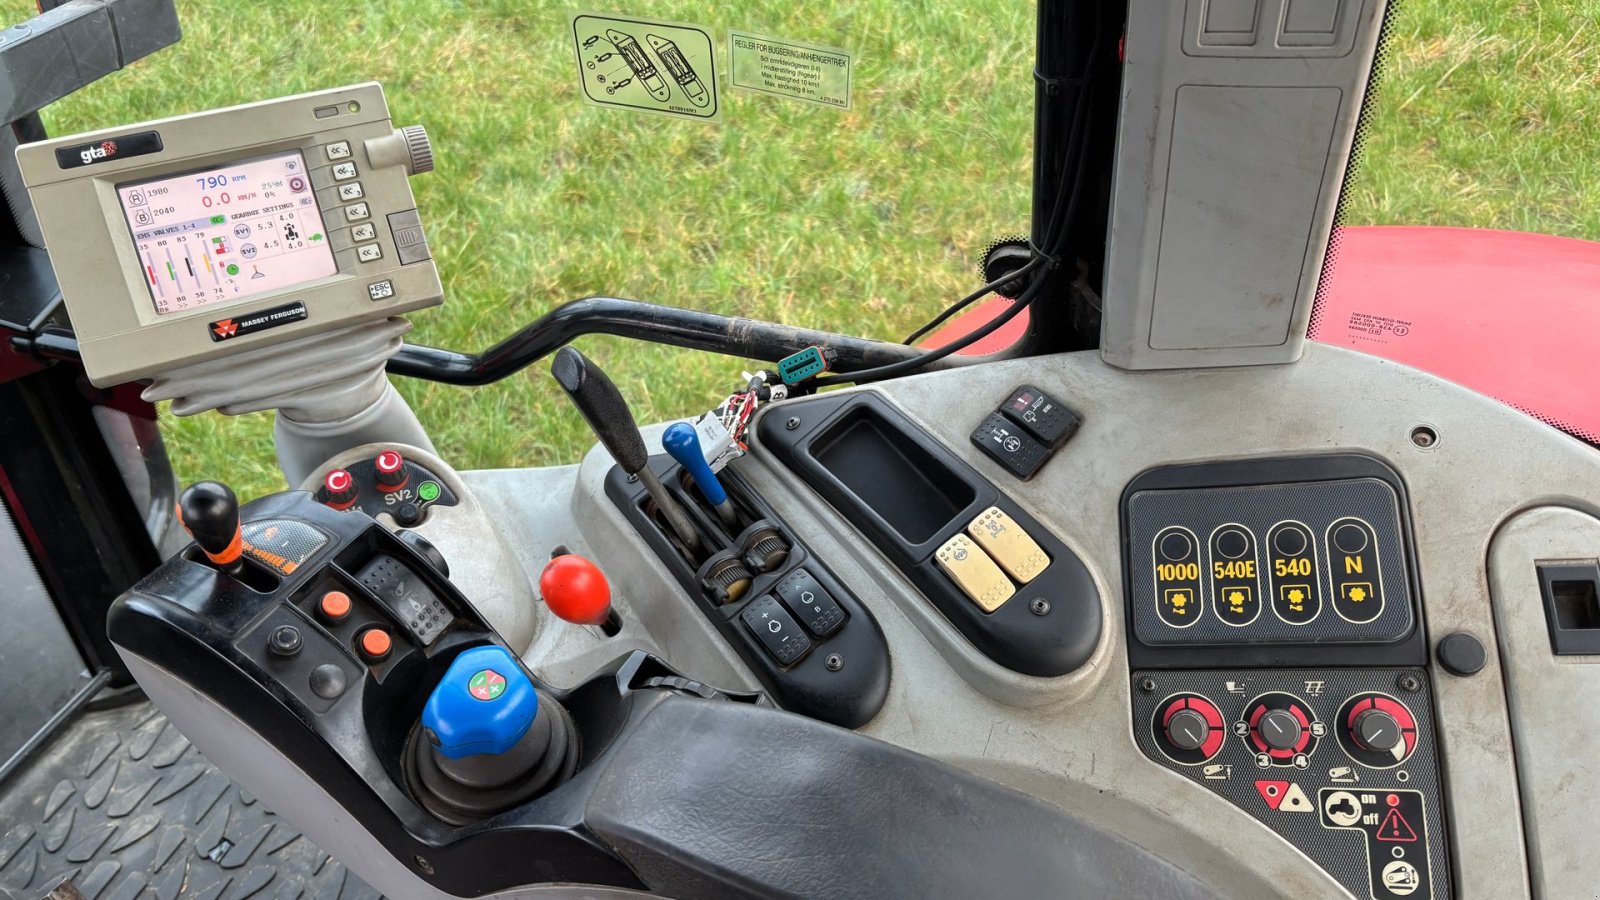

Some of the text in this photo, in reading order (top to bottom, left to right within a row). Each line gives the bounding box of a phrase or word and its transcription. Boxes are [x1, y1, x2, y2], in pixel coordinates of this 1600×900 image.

[735, 40, 756, 50] REGLER
[756, 43, 768, 53] FOR
[80, 146, 108, 164] gta
[196, 174, 247, 190] 790 RPM
[147, 187, 169, 198] 1980
[202, 192, 231, 208] 0.0
[153, 206, 176, 217] 2040
[231, 202, 295, 221] GEARBOX SETTINGS
[279, 212, 295, 222] 4.0
[153, 226, 181, 238] VALVES
[182, 223, 197, 231] 1-4
[235, 228, 251, 236] SV1
[257, 221, 274, 231] 5.3
[195, 231, 207, 240] 79
[241, 246, 258, 255] SV2
[263, 240, 280, 250] 4.5
[287, 241, 304, 251] 4.0
[212, 286, 224, 295] 74
[374, 283, 390, 292] ESC
[241, 306, 306, 328] MASSEY FERGUSON
[384, 489, 413, 505] SV2
[1214, 560, 1256, 579] 540E
[1275, 558, 1312, 577] 540
[1345, 556, 1363, 574] N
[1157, 563, 1199, 581] 1000
[1236, 723, 1247, 735] 2
[1312, 723, 1325, 735] 5
[1258, 755, 1269, 767] 3
[1295, 755, 1308, 768] 4
[1361, 794, 1377, 804] on
[1363, 812, 1379, 825] off
